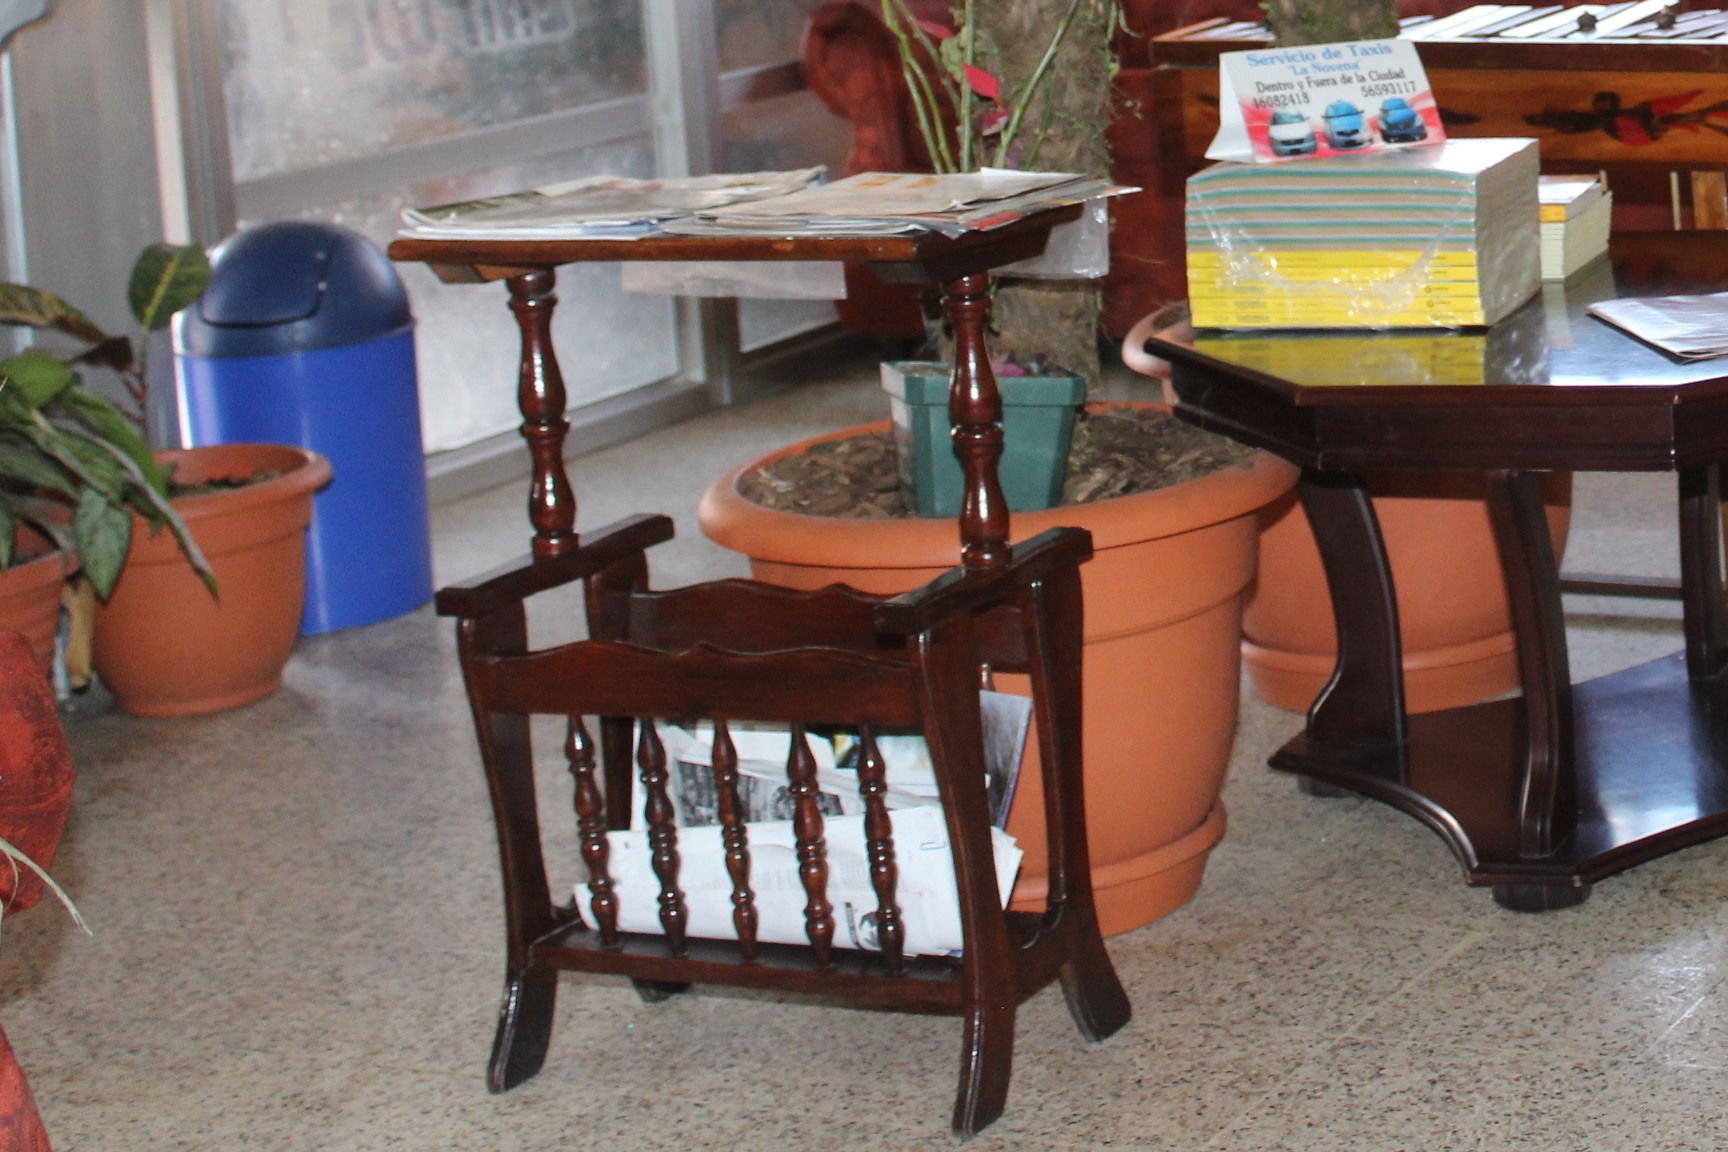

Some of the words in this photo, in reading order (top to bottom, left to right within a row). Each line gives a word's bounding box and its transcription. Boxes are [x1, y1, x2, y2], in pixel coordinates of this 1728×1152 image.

[1246, 52, 1316, 65] Servicio
[1322, 48, 1342, 59] de
[1347, 43, 1392, 56] Taxis
[1256, 81, 1293, 93] Dentro
[1297, 80, 1304, 90] y
[1307, 75, 1338, 87] Fuera
[1341, 73, 1353, 84] de
[1354, 71, 1366, 83] la
[1368, 67, 1405, 82] Ciudad
